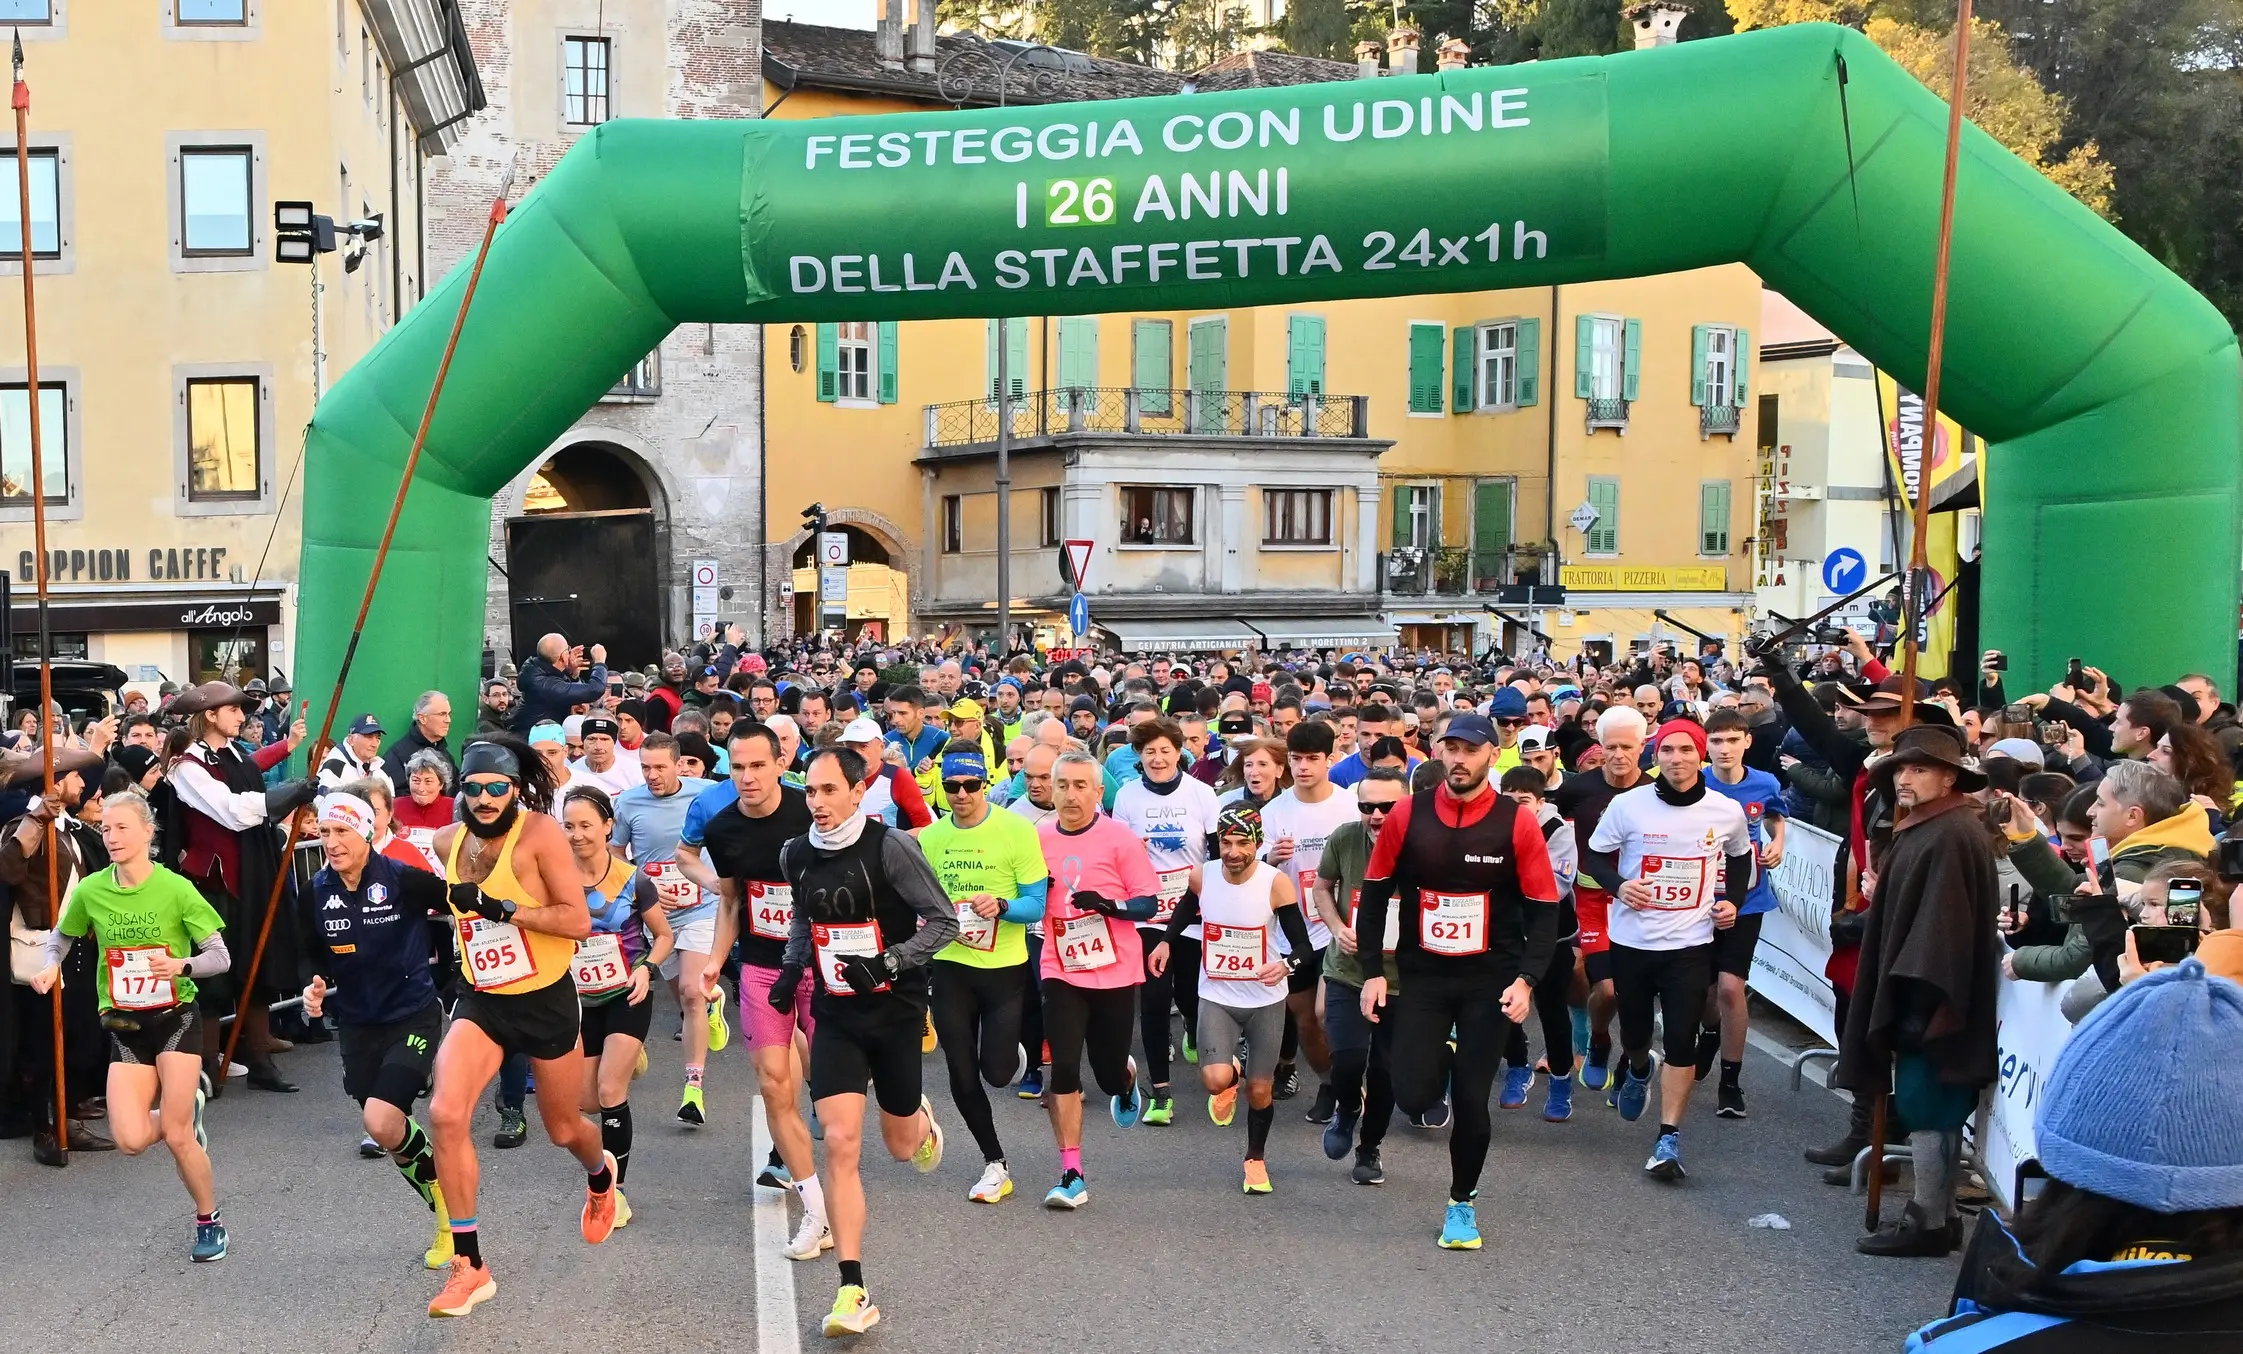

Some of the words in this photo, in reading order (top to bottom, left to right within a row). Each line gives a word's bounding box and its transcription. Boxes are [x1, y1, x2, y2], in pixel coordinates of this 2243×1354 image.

[805, 119, 1143, 170] FESTEGGIA
[1162, 107, 1300, 153] CON
[1323, 87, 1531, 142] UDINE
[1015, 181, 1028, 229] I
[1048, 177, 1115, 224] 26
[1133, 166, 1288, 224] ANNI
[789, 251, 978, 293] DELLA
[994, 234, 1342, 289] STAFFETTA
[1362, 220, 1548, 271] 24x1h
[1563, 571, 1614, 585] TRATTORIA
[1624, 571, 1666, 585] PIZZERIA
[181, 605, 253, 626] all'Angolo
[1189, 640, 1247, 649] ARTIGIANALE
[1311, 638, 1359, 647] MORETTINO
[1362, 637, 1368, 645] 2
[328, 811, 345, 821] Red
[345, 815, 361, 830] Bull
[1146, 805, 1187, 819] CMP
[943, 861, 984, 870] CARNIA
[1465, 854, 1481, 862] Quis
[660, 883, 691, 897] 45
[1653, 886, 1692, 901] 159
[1157, 896, 1185, 913] 36
[108, 911, 158, 926] SUSANS'
[363, 914, 401, 925] FALCONERI
[1431, 922, 1472, 939] 621
[1065, 937, 1105, 960] 414
[474, 944, 517, 972] 695
[1215, 953, 1255, 971] 784
[579, 962, 617, 983] 613
[122, 976, 159, 995] 177
